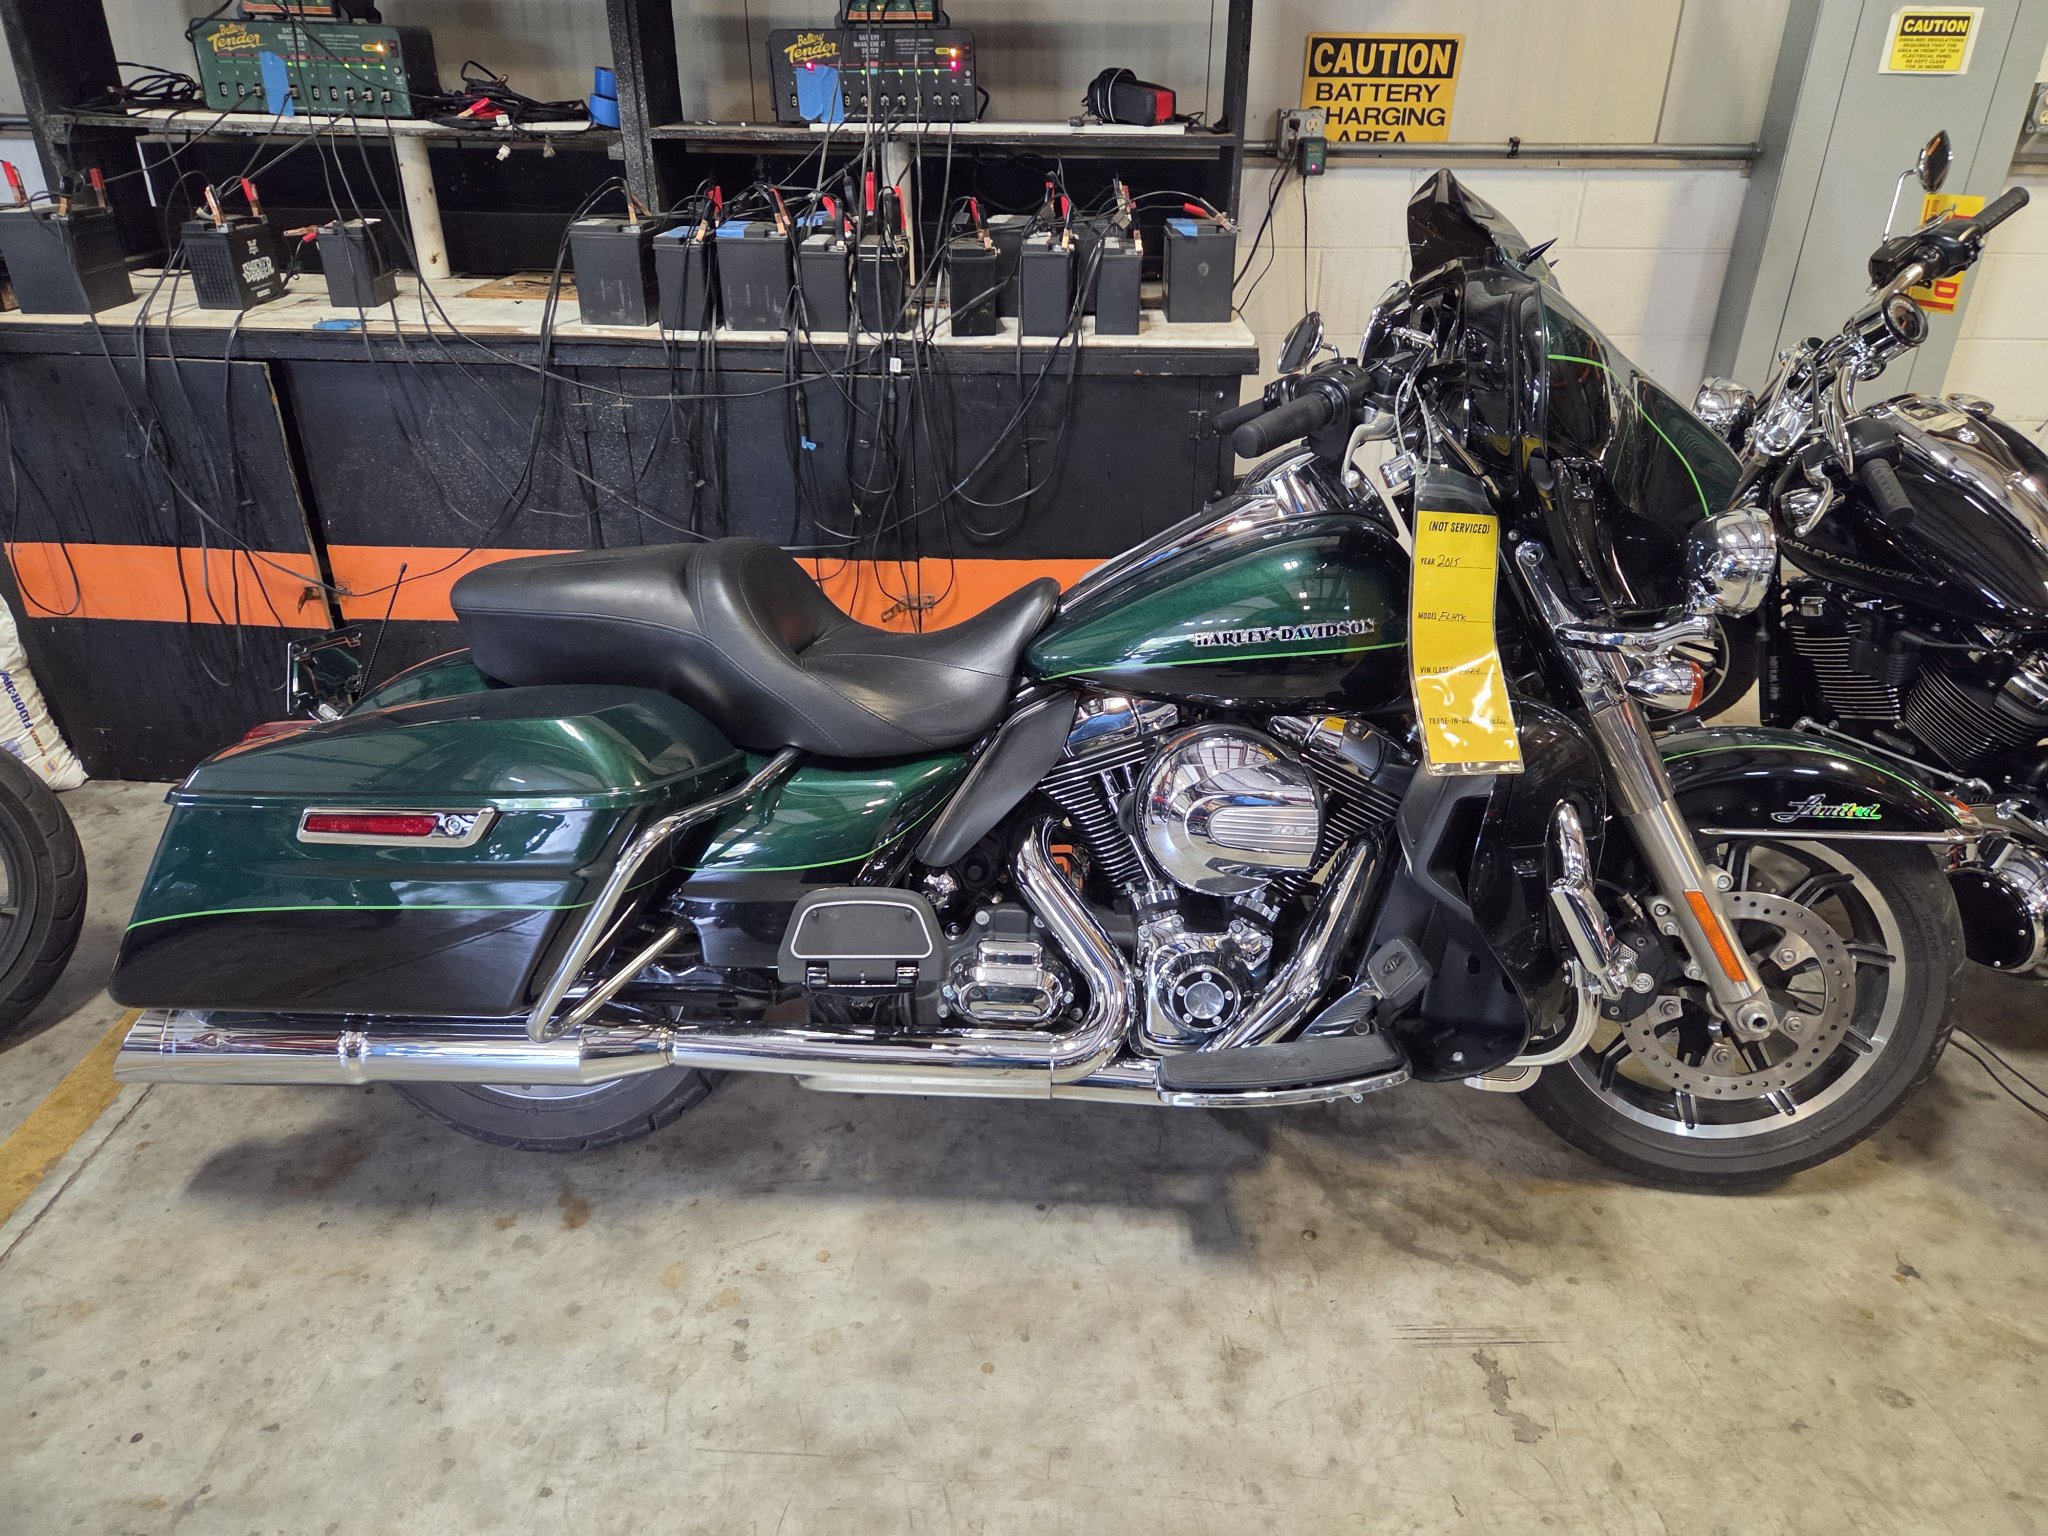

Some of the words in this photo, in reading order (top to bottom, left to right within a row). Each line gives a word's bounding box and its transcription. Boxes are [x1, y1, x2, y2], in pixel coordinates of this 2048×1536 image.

[219, 22, 247, 35] Battery
[1903, 19, 1968, 33] CAUTION
[207, 32, 260, 52] Tender
[797, 32, 825, 46] Battery
[784, 42, 836, 63] Tender
[1314, 42, 1452, 75] CAUTION
[1316, 82, 1440, 103] BATTERY
[1337, 130, 1406, 142] AREA
[1429, 521, 1449, 532] (NOT
[1450, 522, 1490, 534] SERVICED)
[1420, 557, 1435, 565] YEAR
[1437, 554, 1461, 568] 2015
[1418, 612, 1437, 620] MODEL
[1770, 793, 1882, 823] Limited
